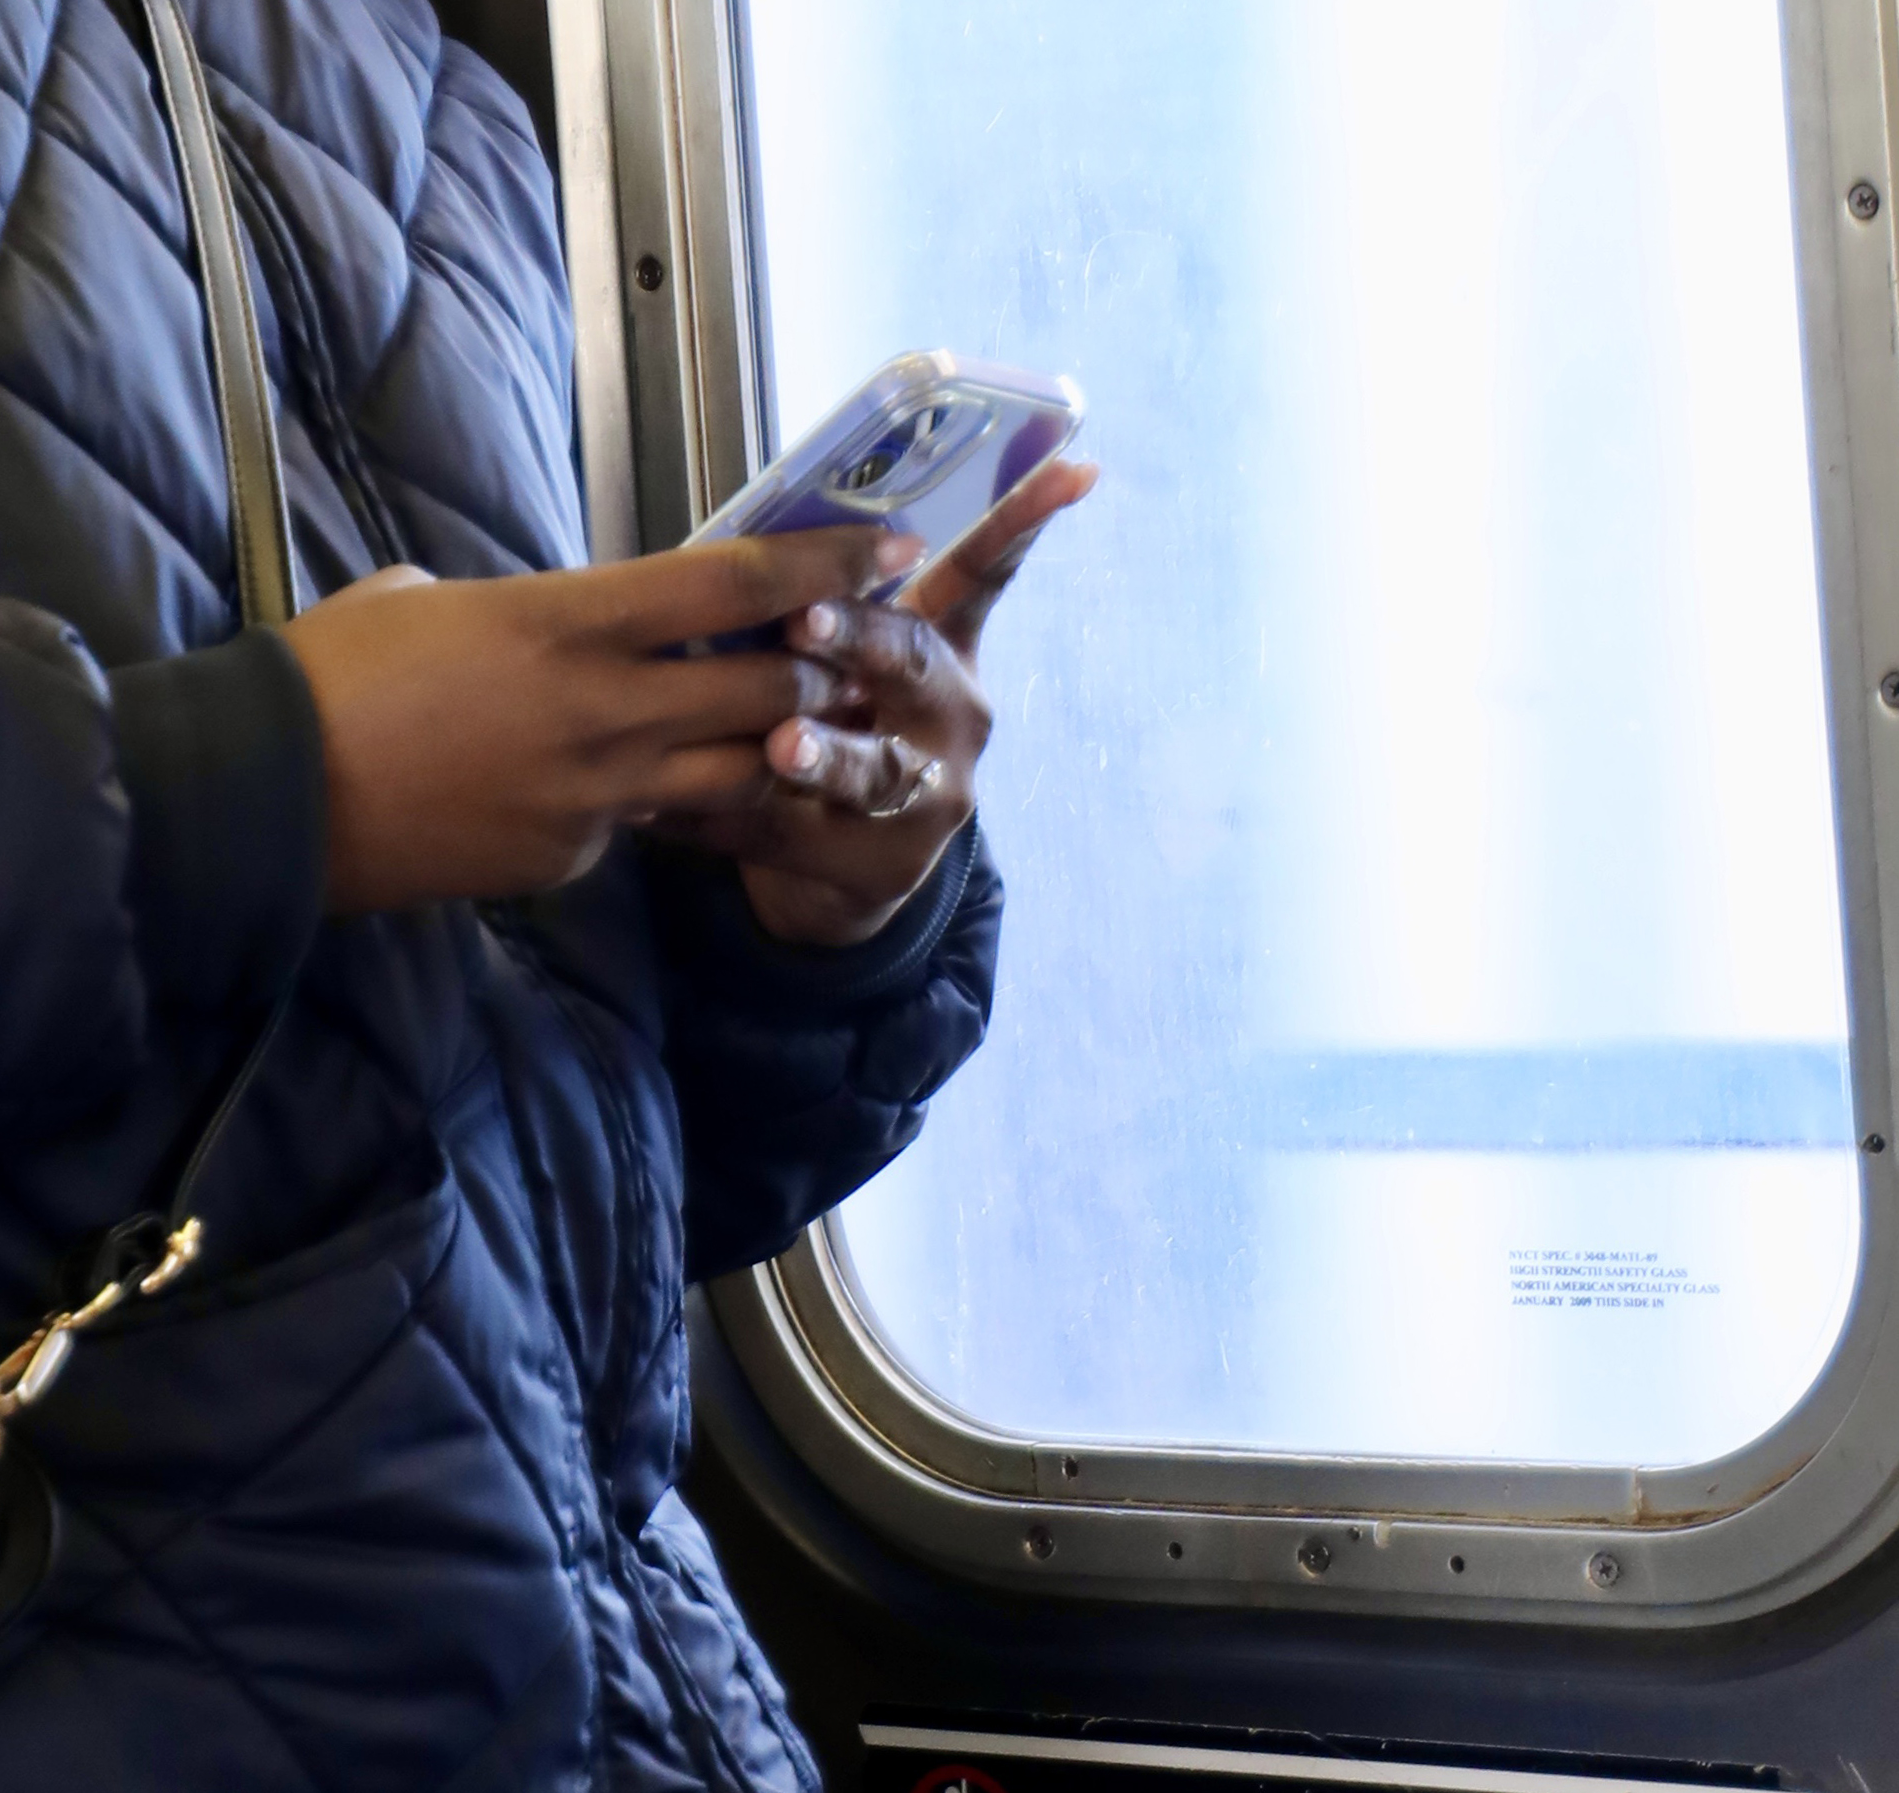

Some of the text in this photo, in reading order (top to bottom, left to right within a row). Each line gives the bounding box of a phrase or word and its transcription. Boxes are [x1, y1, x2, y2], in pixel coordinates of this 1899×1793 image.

[1541, 1265, 1602, 1277] STRENGTH
[1604, 1266, 1648, 1277] SAFETY
[1650, 1267, 1688, 1278] GLASS
[1511, 1280, 1721, 1294] NORTH AMERICAN SPECIALTY GLASS
[1512, 1295, 1564, 1306] JANUARY
[1594, 1296, 1621, 1307] THIS
[1623, 1296, 1650, 1308] SIDE
[1652, 1297, 1664, 1308] IN
